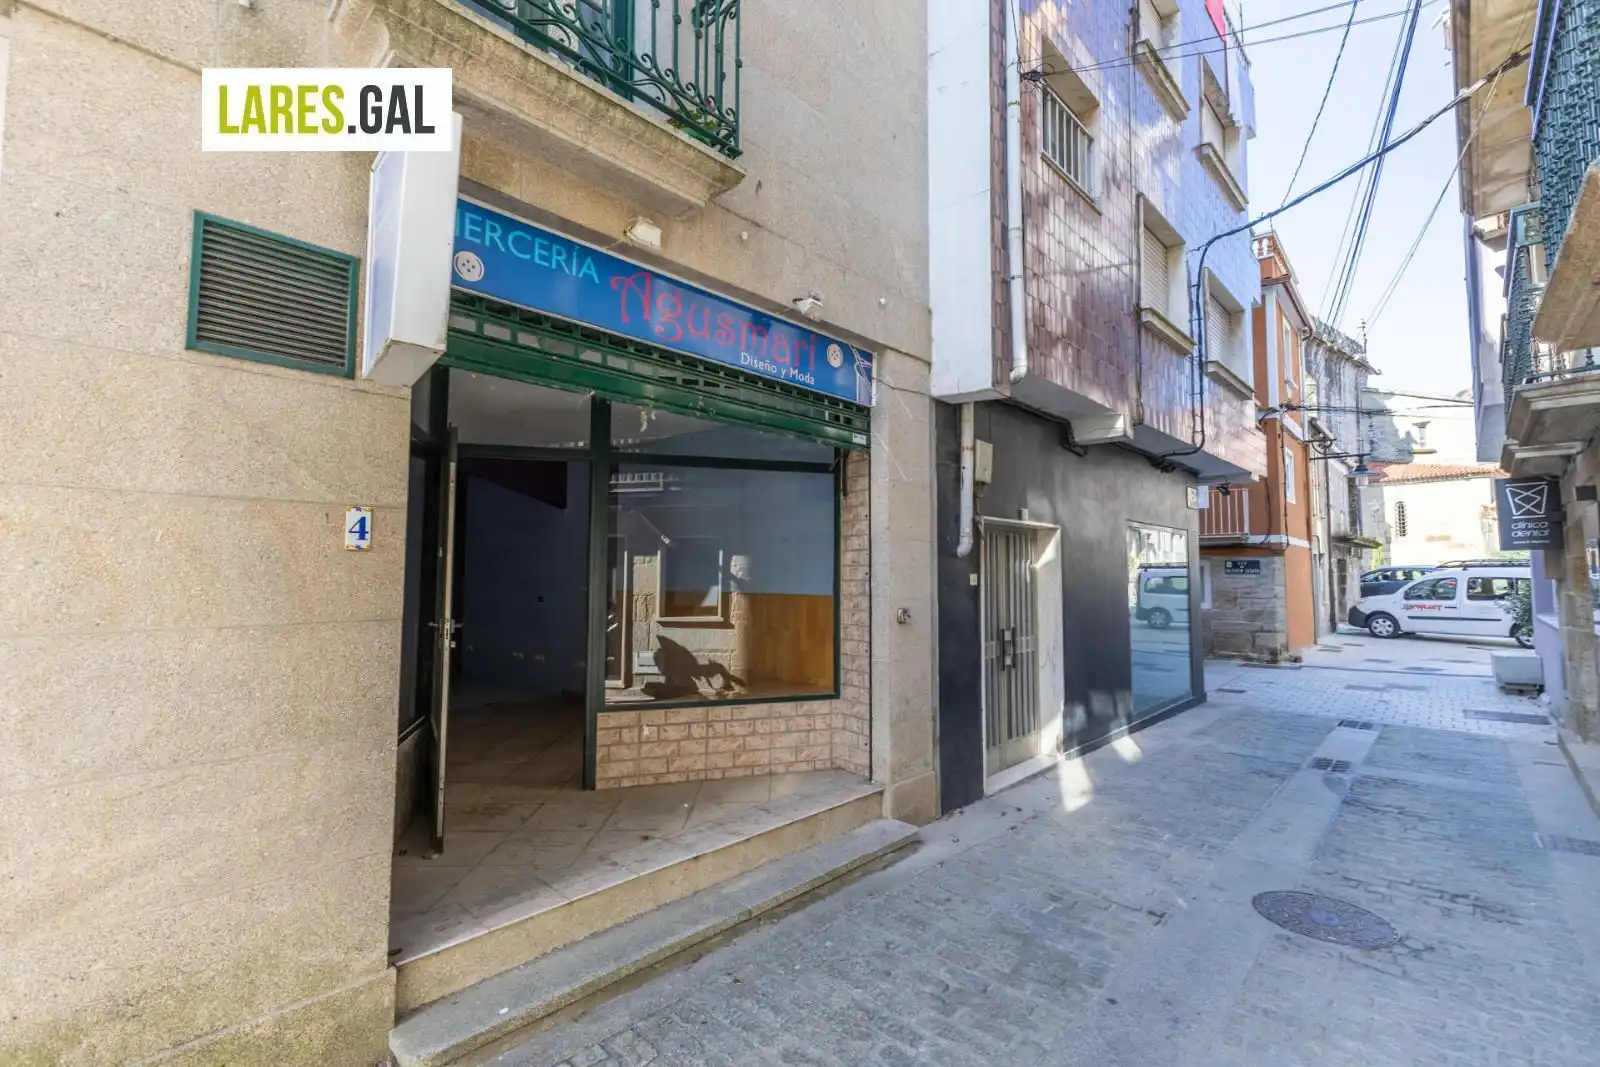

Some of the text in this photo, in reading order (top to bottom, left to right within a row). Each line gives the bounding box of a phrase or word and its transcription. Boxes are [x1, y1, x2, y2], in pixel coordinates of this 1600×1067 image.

[454, 208, 600, 284] ERCERÍA
[610, 271, 817, 372] Agusmari
[740, 352, 816, 386] Diseño y Moda
[348, 516, 369, 541] 4
